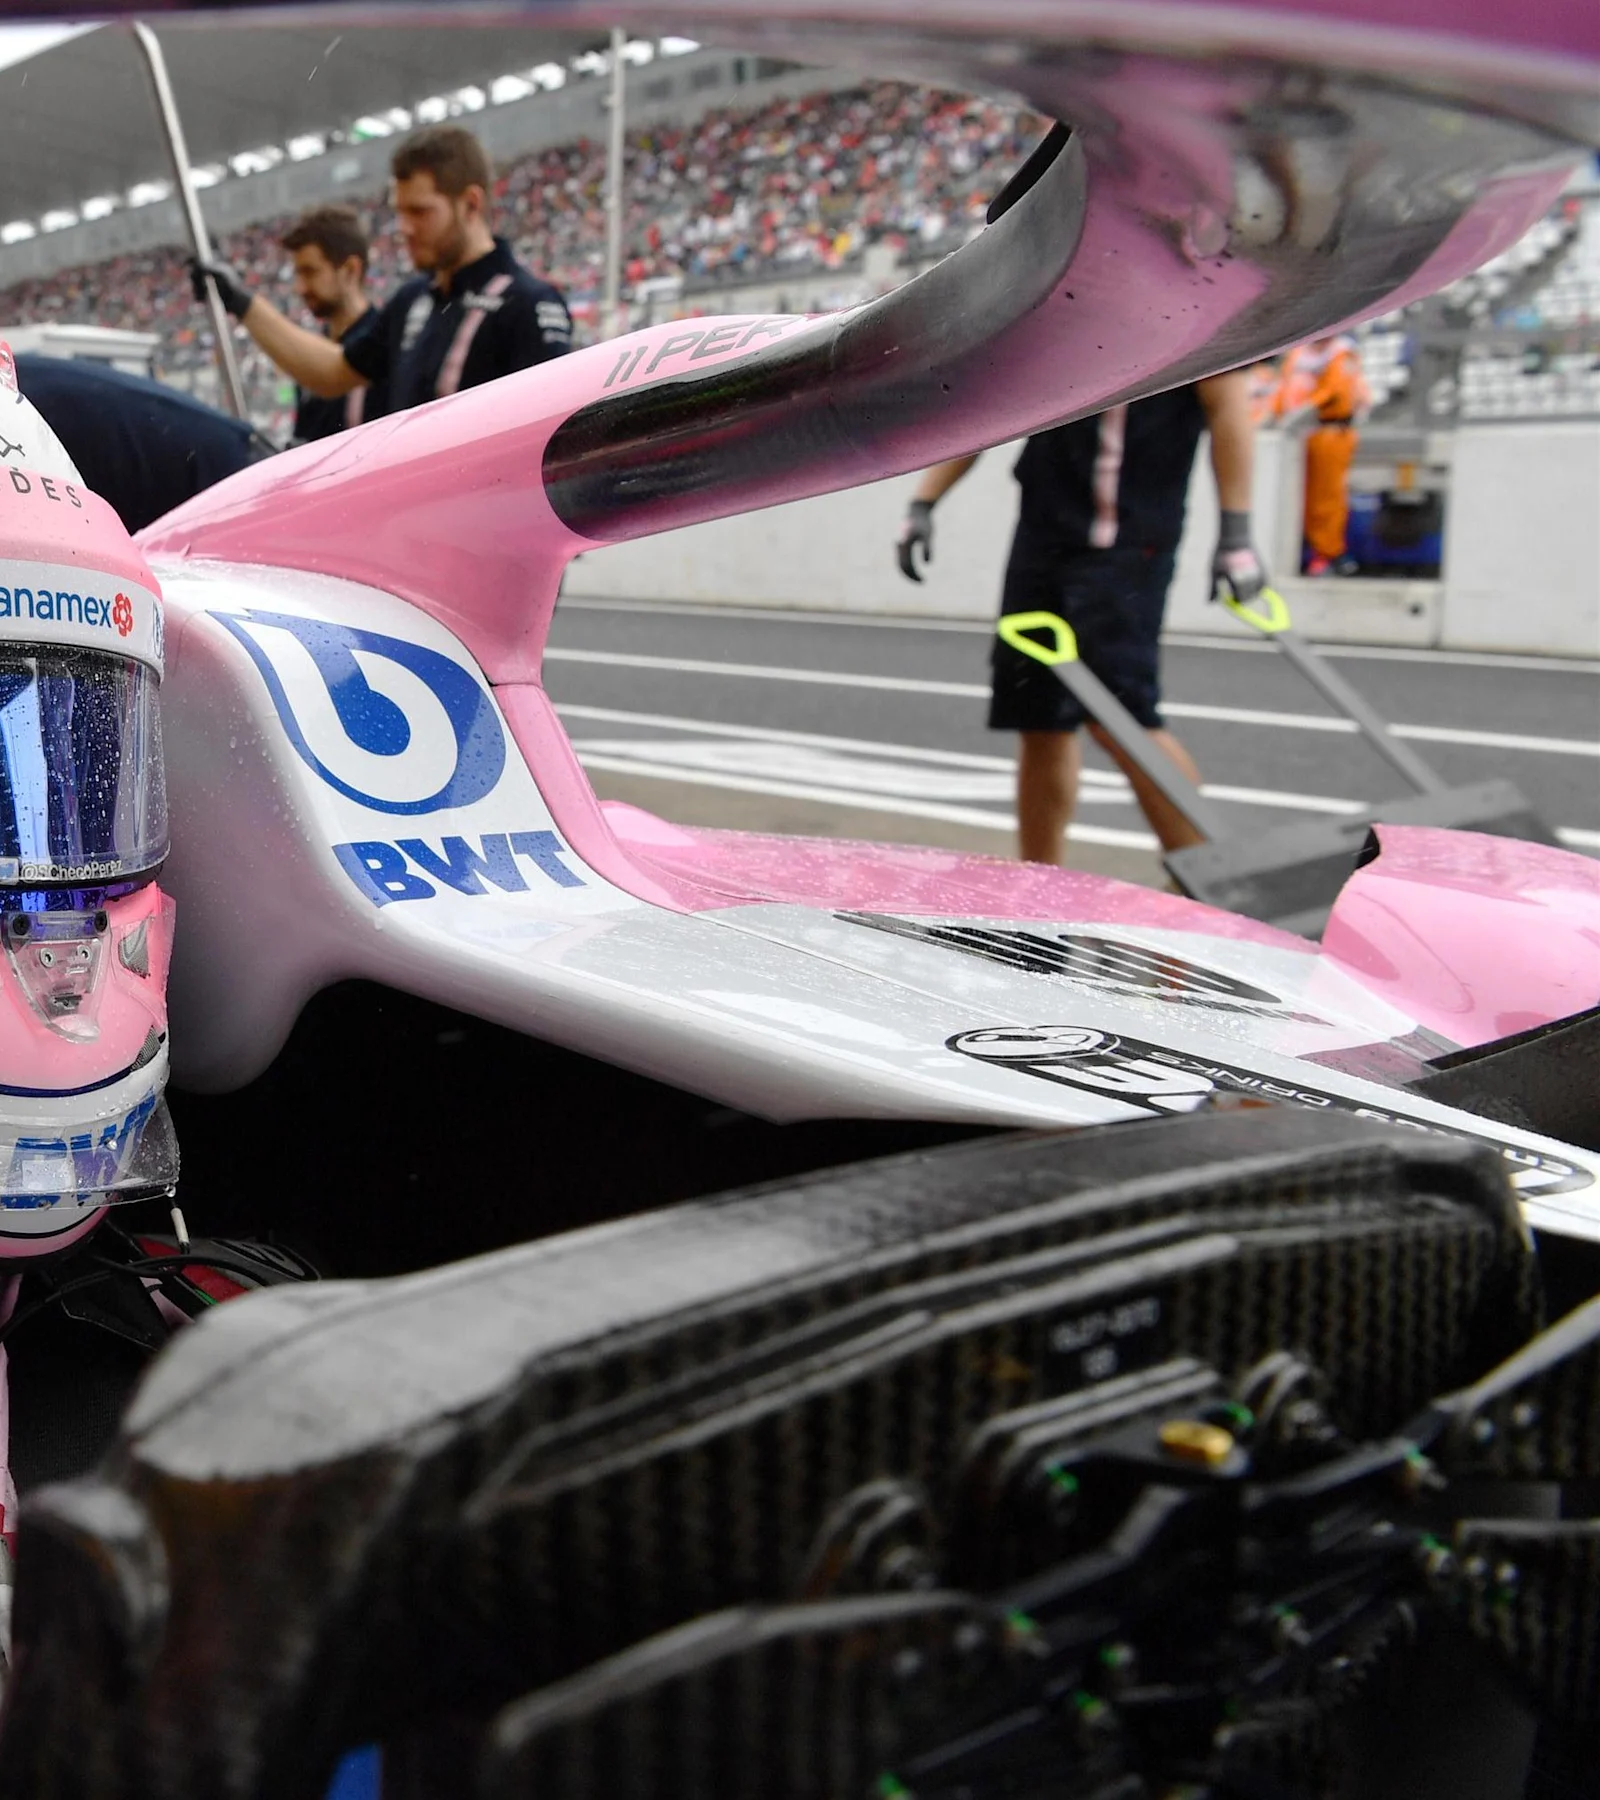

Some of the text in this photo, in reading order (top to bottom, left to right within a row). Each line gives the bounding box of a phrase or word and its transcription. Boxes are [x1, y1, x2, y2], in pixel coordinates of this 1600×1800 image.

[21, 858, 123, 884] @SChecoPerez
[331, 829, 587, 909] BWT
[1148, 1050, 1332, 1108] DRINKS
